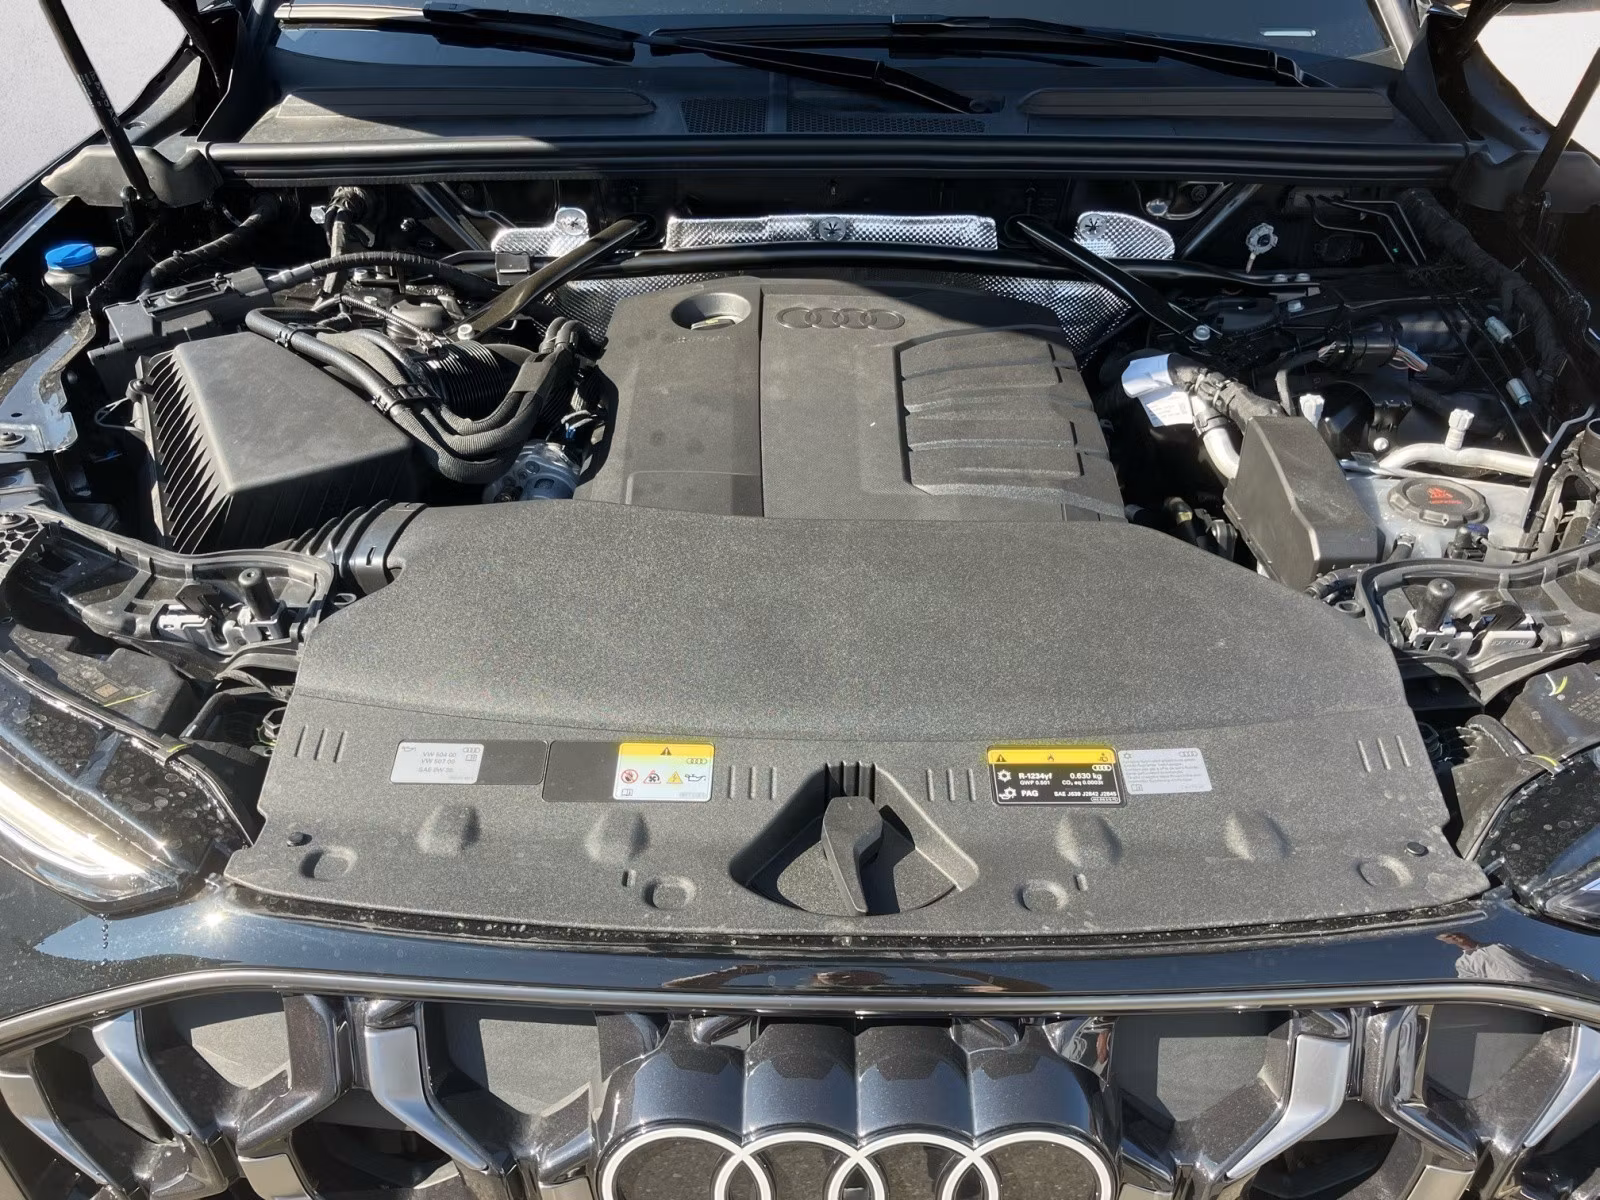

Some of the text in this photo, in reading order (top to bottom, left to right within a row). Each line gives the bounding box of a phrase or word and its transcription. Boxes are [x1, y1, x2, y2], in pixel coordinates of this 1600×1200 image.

[1018, 772, 1053, 780] R-1234yf
[1069, 772, 1103, 781] 0.630 kg
